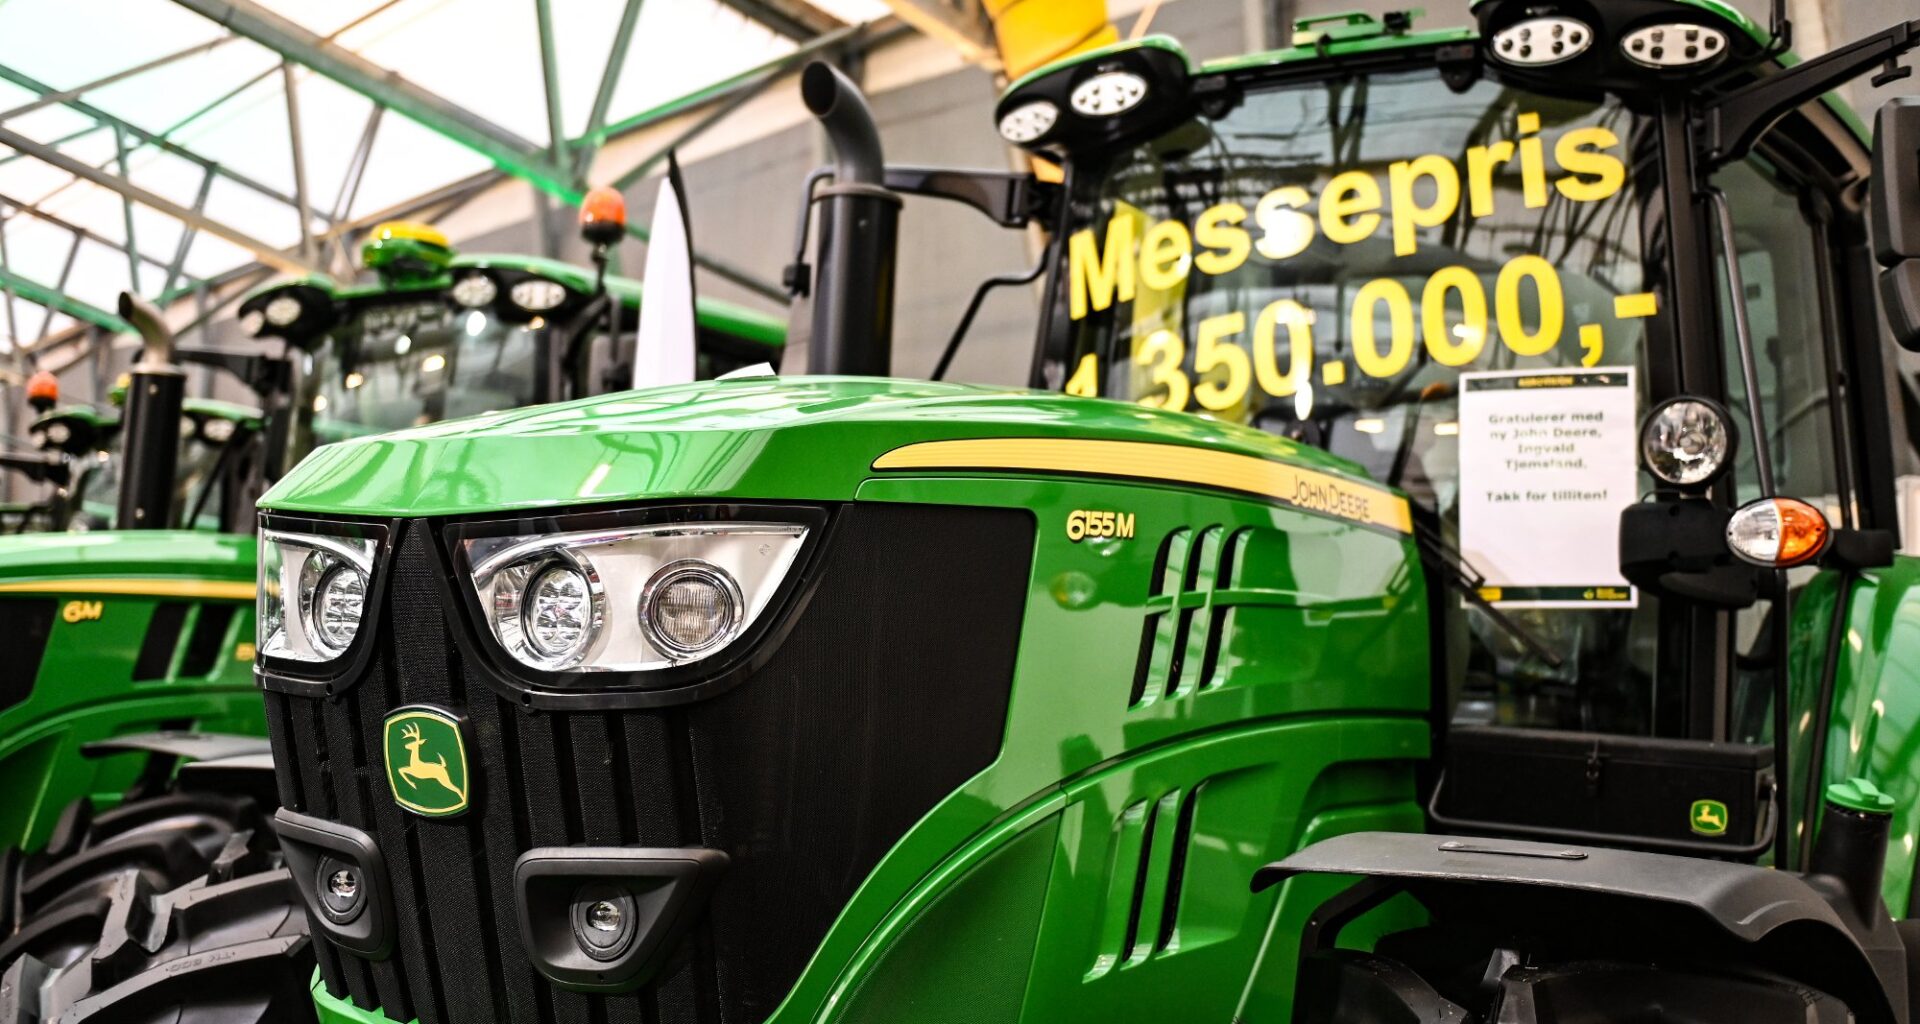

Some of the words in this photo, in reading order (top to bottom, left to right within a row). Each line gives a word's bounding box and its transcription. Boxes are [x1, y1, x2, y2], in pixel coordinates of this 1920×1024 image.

[1069, 112, 1625, 320] Messepris
[1489, 412, 1565, 424] Gratulerer
[1571, 411, 1603, 422] med
[1490, 430, 1506, 441] ny
[1514, 428, 1548, 439] John
[1553, 427, 1602, 439] Deere,
[1518, 443, 1574, 455] Ingvald
[1291, 474, 1328, 508] JOHN
[1329, 484, 1370, 518] DEERE
[1487, 491, 1520, 502] Takk
[1526, 490, 1545, 501] for
[1552, 489, 1607, 501] tilliten!
[63, 600, 103, 623] 6M
